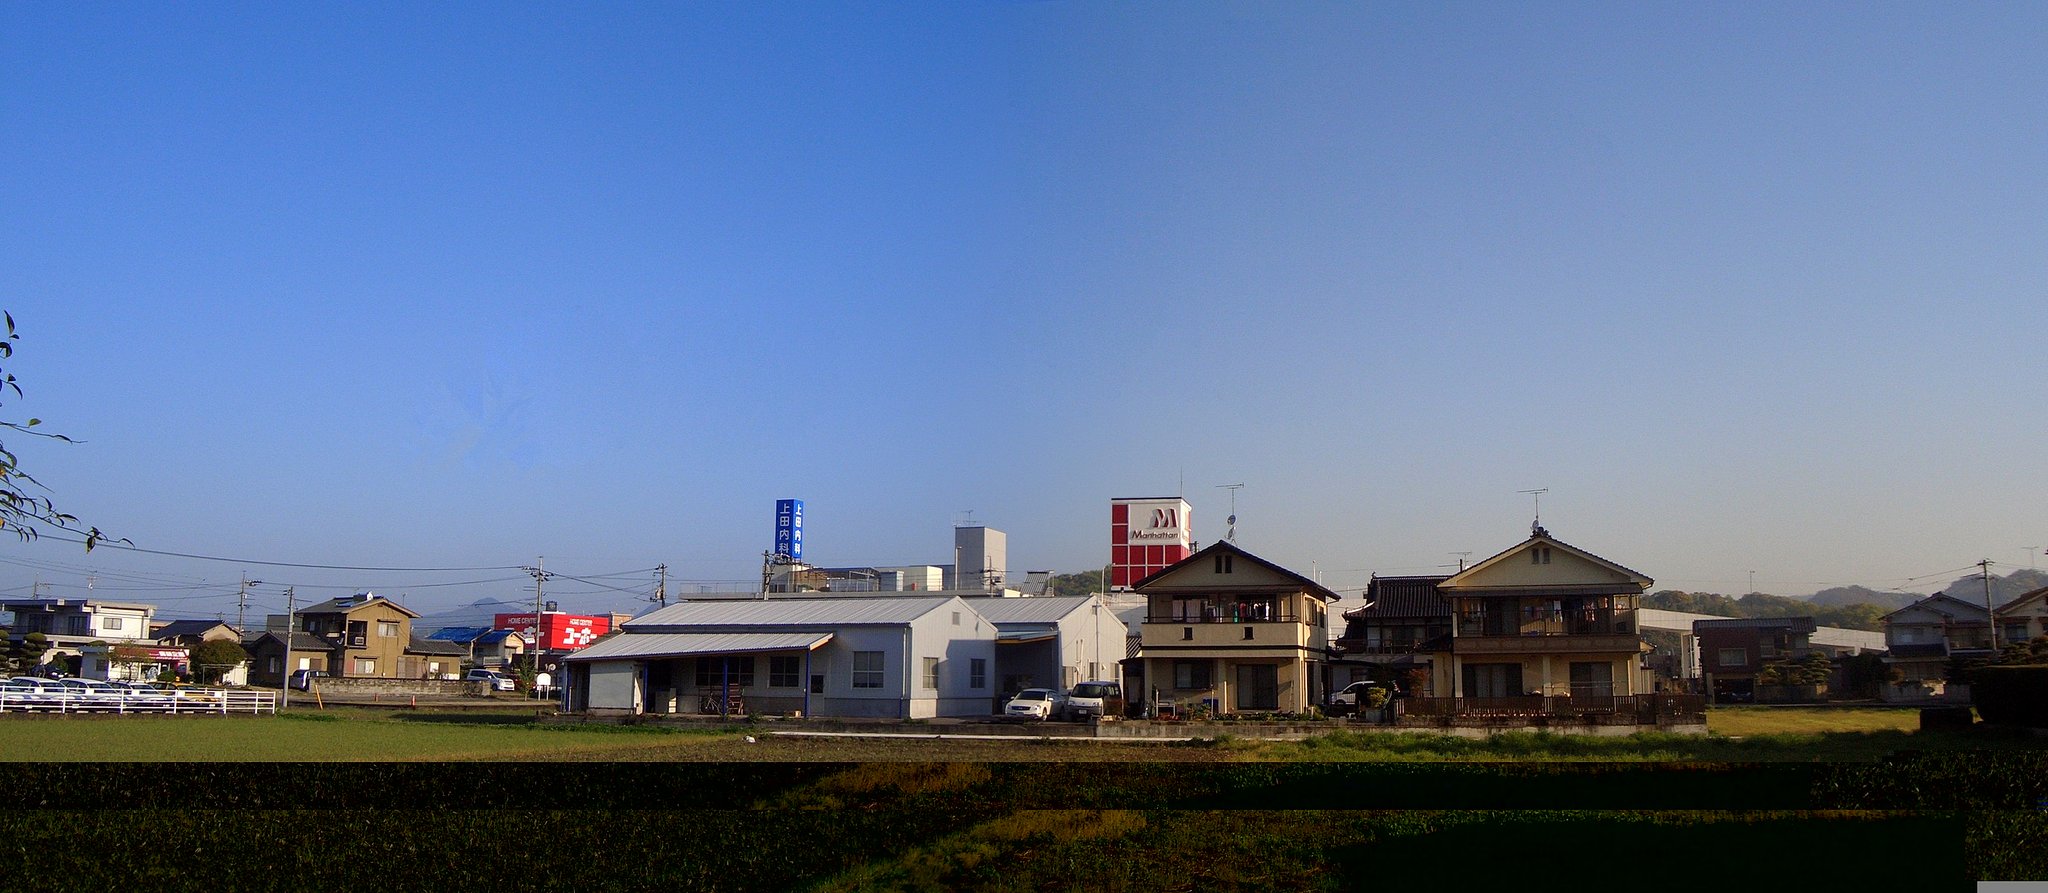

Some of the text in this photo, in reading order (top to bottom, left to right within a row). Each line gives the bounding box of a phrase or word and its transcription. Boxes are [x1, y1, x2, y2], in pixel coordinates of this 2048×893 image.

[779, 503, 790, 553] 上田内科
[1131, 530, 1179, 540] Manhattan
